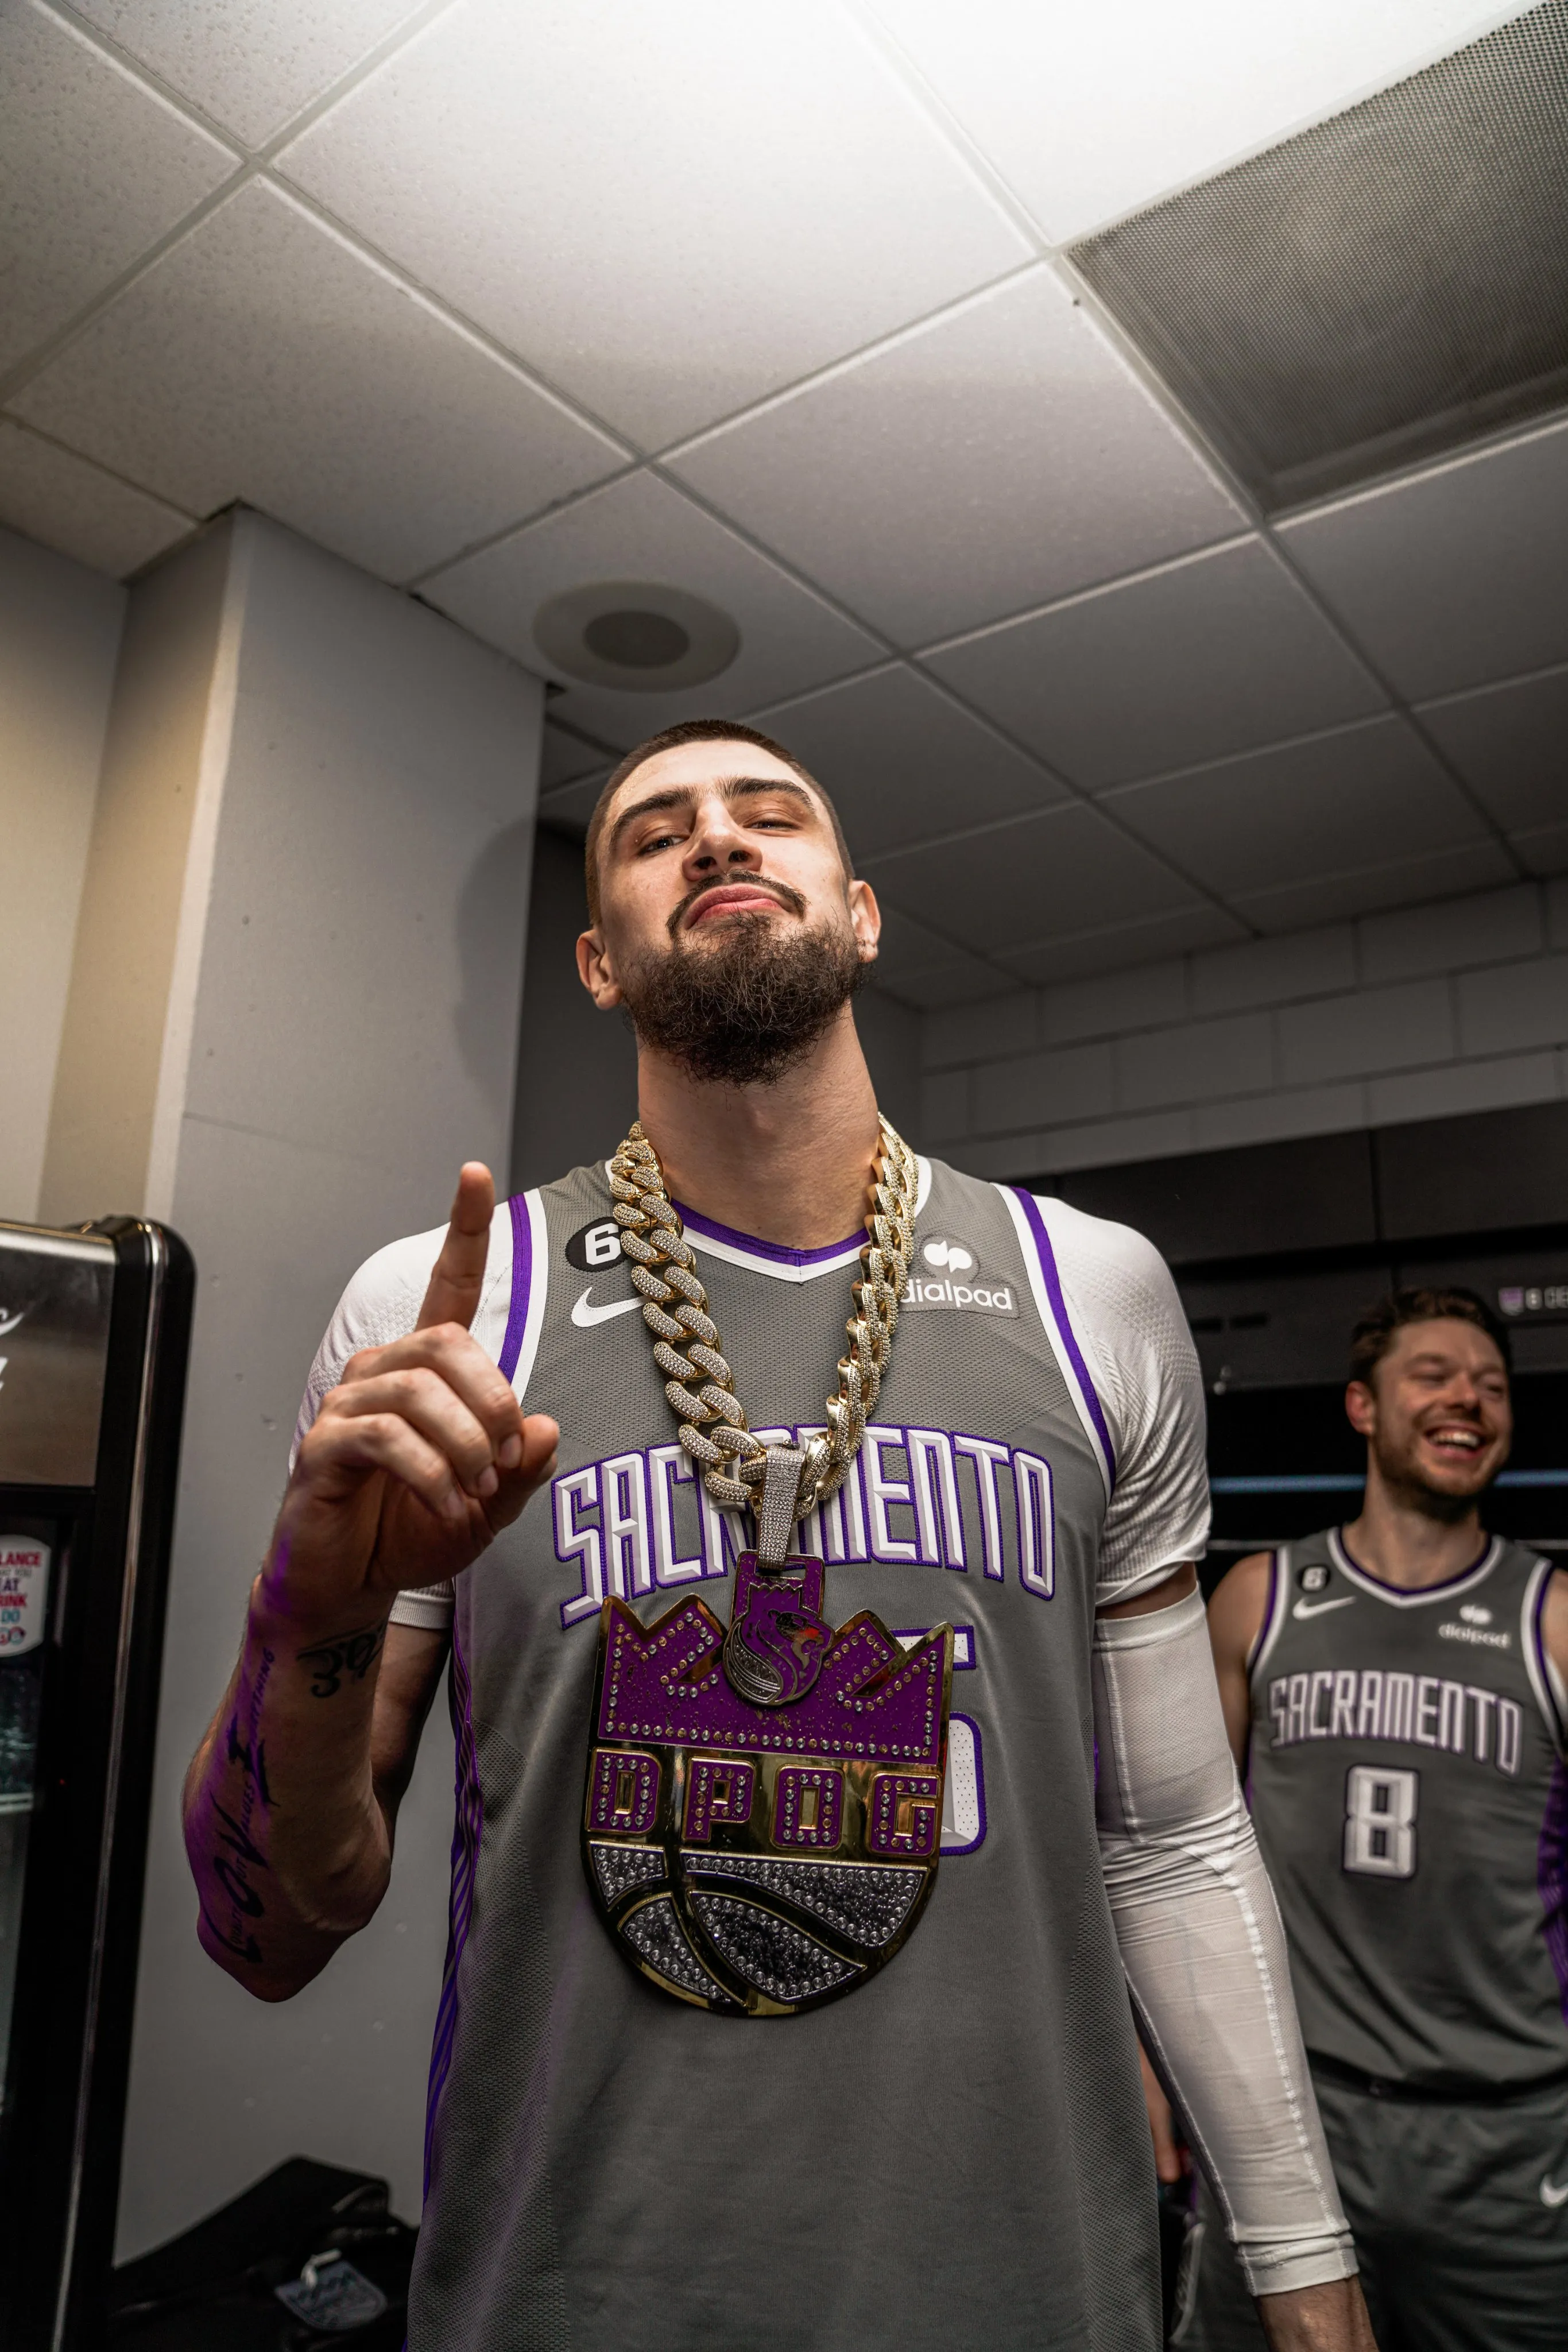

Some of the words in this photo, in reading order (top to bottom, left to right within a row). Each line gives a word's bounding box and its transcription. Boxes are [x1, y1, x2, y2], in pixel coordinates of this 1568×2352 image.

[584, 1223, 621, 1266] 6
[900, 1279, 1013, 1310] dialpad
[1438, 1622, 1511, 1649] dialpad
[1269, 1670, 1523, 1778] SACRAMENTO
[586, 1747, 942, 1858] DPOG
[1342, 1763, 1420, 1879] 8
